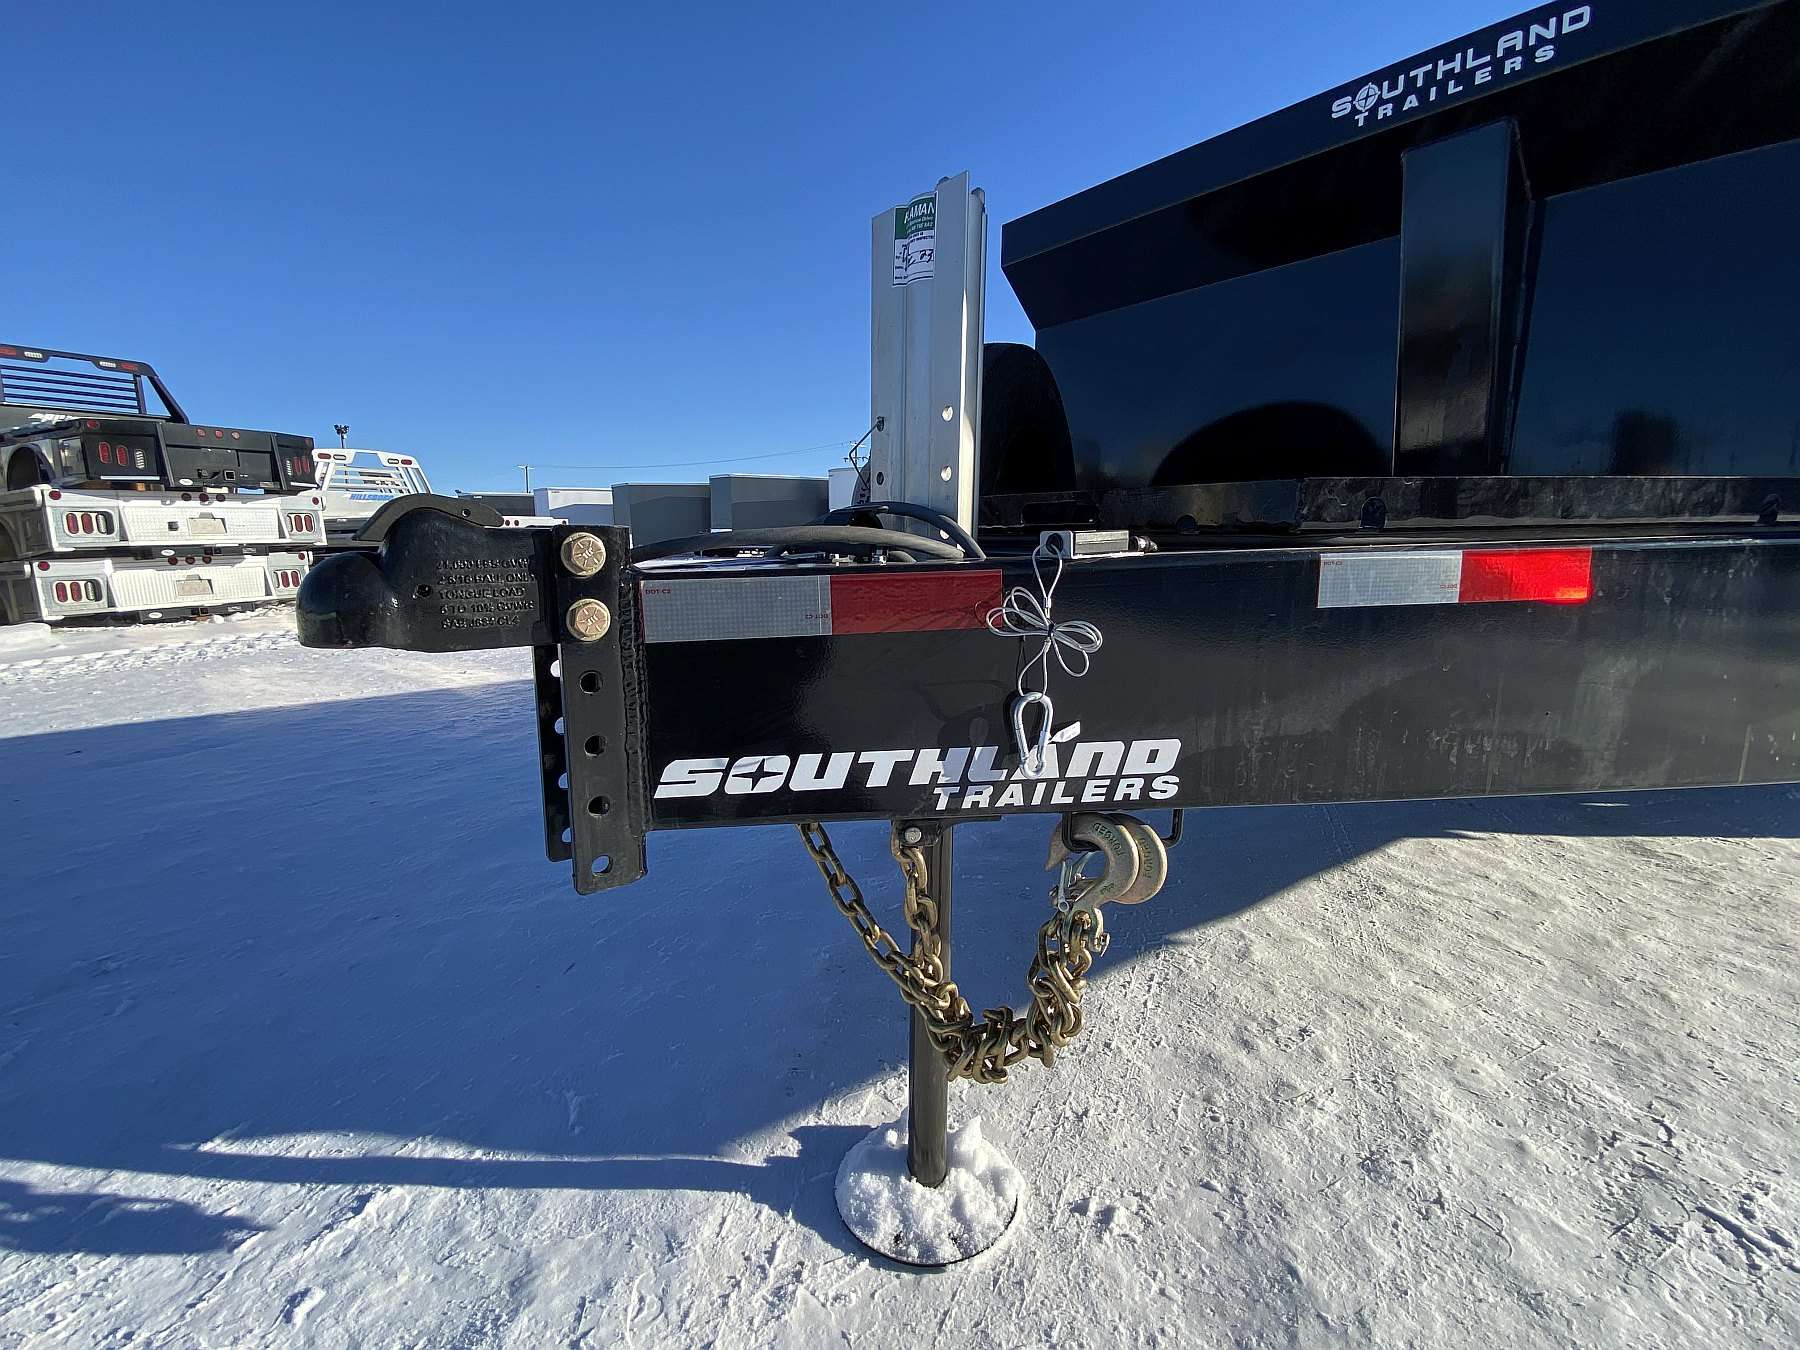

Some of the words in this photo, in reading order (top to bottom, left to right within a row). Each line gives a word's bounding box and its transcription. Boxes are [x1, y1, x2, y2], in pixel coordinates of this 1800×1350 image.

[1331, 5, 1591, 118] SOUTHLAND
[1354, 45, 1554, 127] TRAILERS
[439, 588, 492, 600] TONGUE
[493, 586, 526, 598] LOAD
[654, 738, 1182, 799] SOUTHLAND
[933, 775, 1181, 811] TRAILERS
